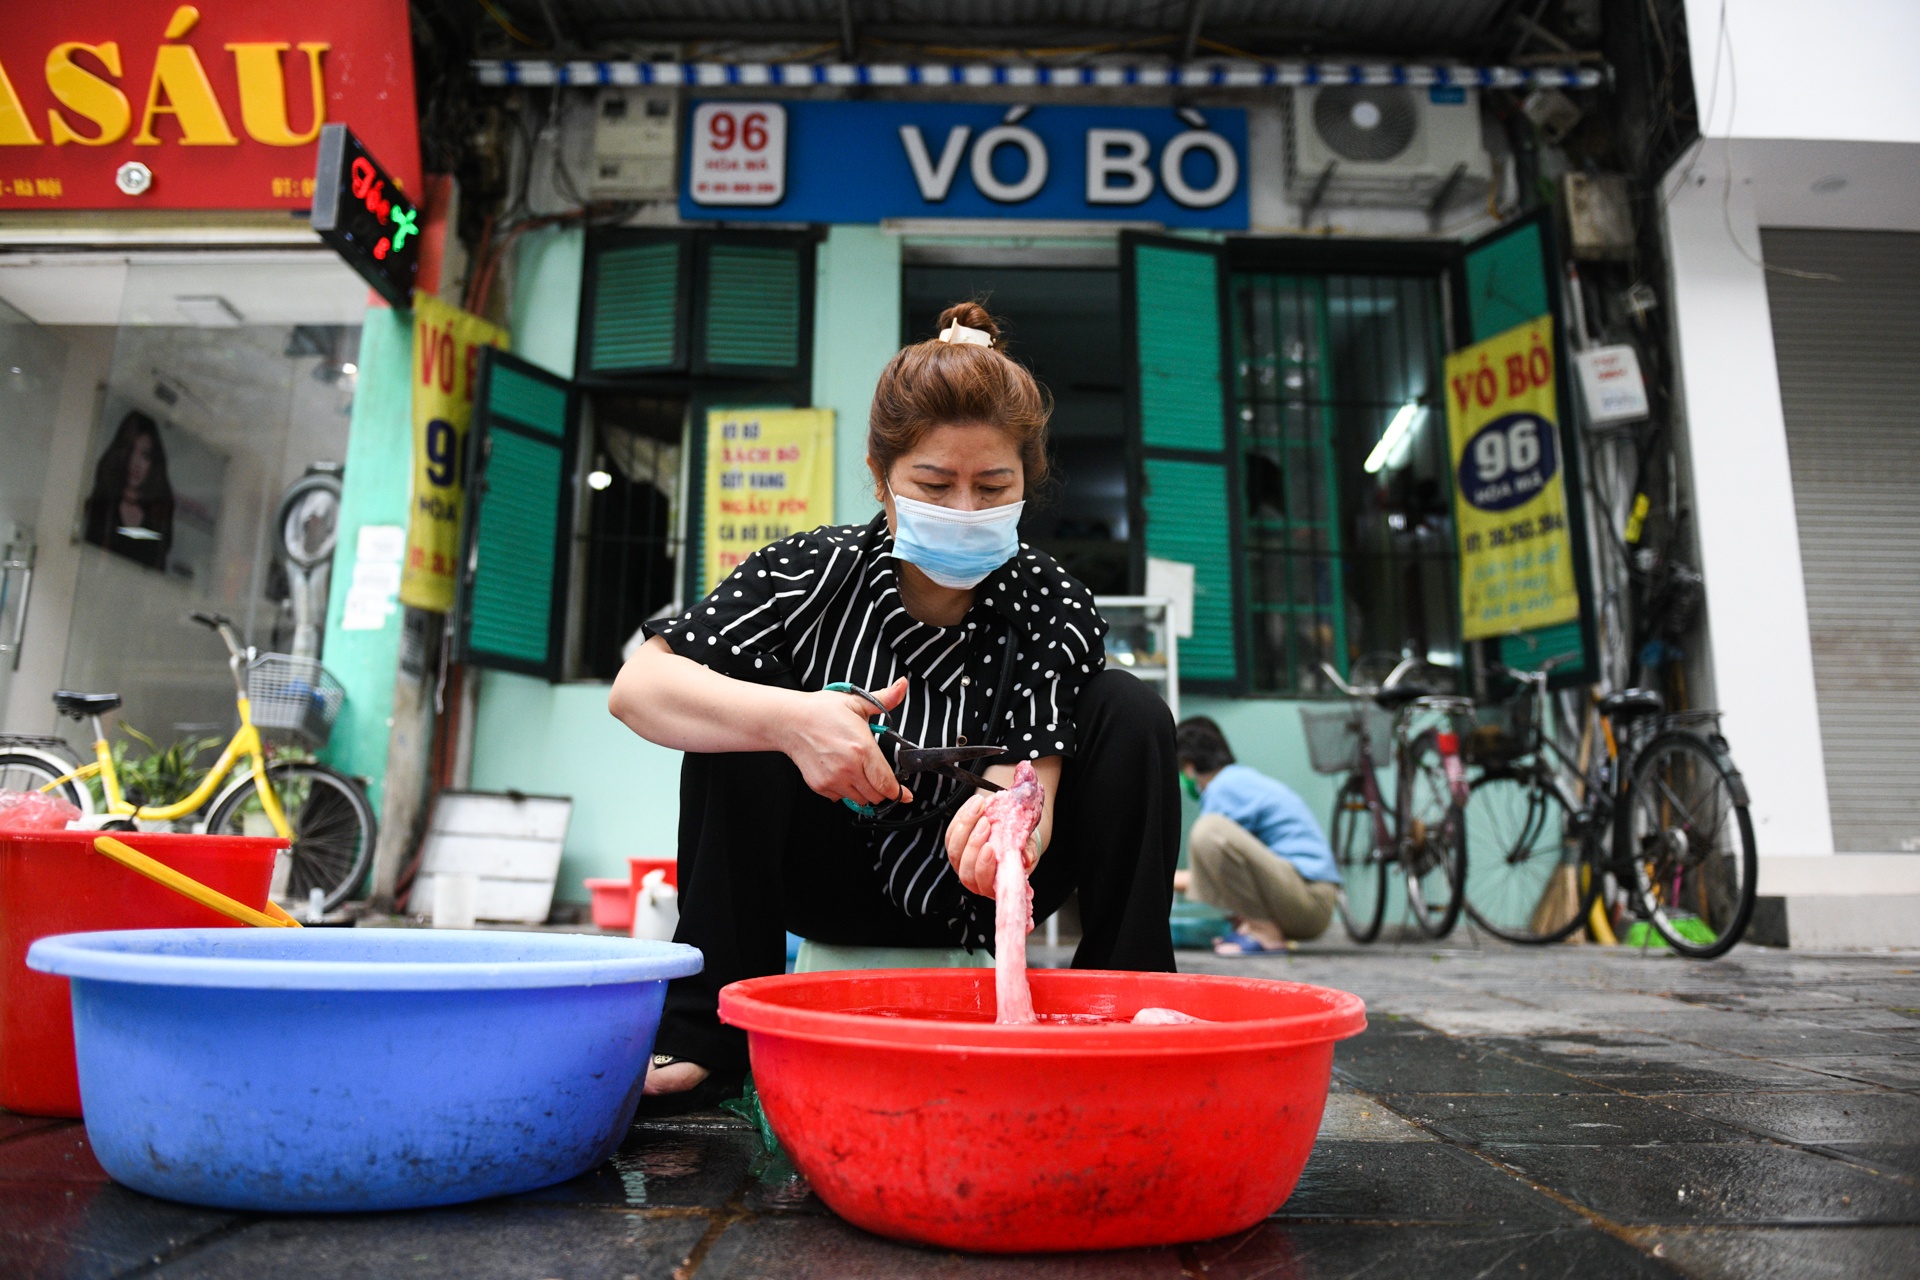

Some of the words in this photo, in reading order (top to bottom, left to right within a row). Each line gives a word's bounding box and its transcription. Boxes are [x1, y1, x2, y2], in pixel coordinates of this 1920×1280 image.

[710, 111, 769, 152] 96
[900, 104, 1050, 202] VÓ
[1086, 107, 1239, 207] BÒ
[420, 319, 456, 396] VÓ
[426, 419, 470, 488] 9
[1474, 419, 1540, 482] 96
